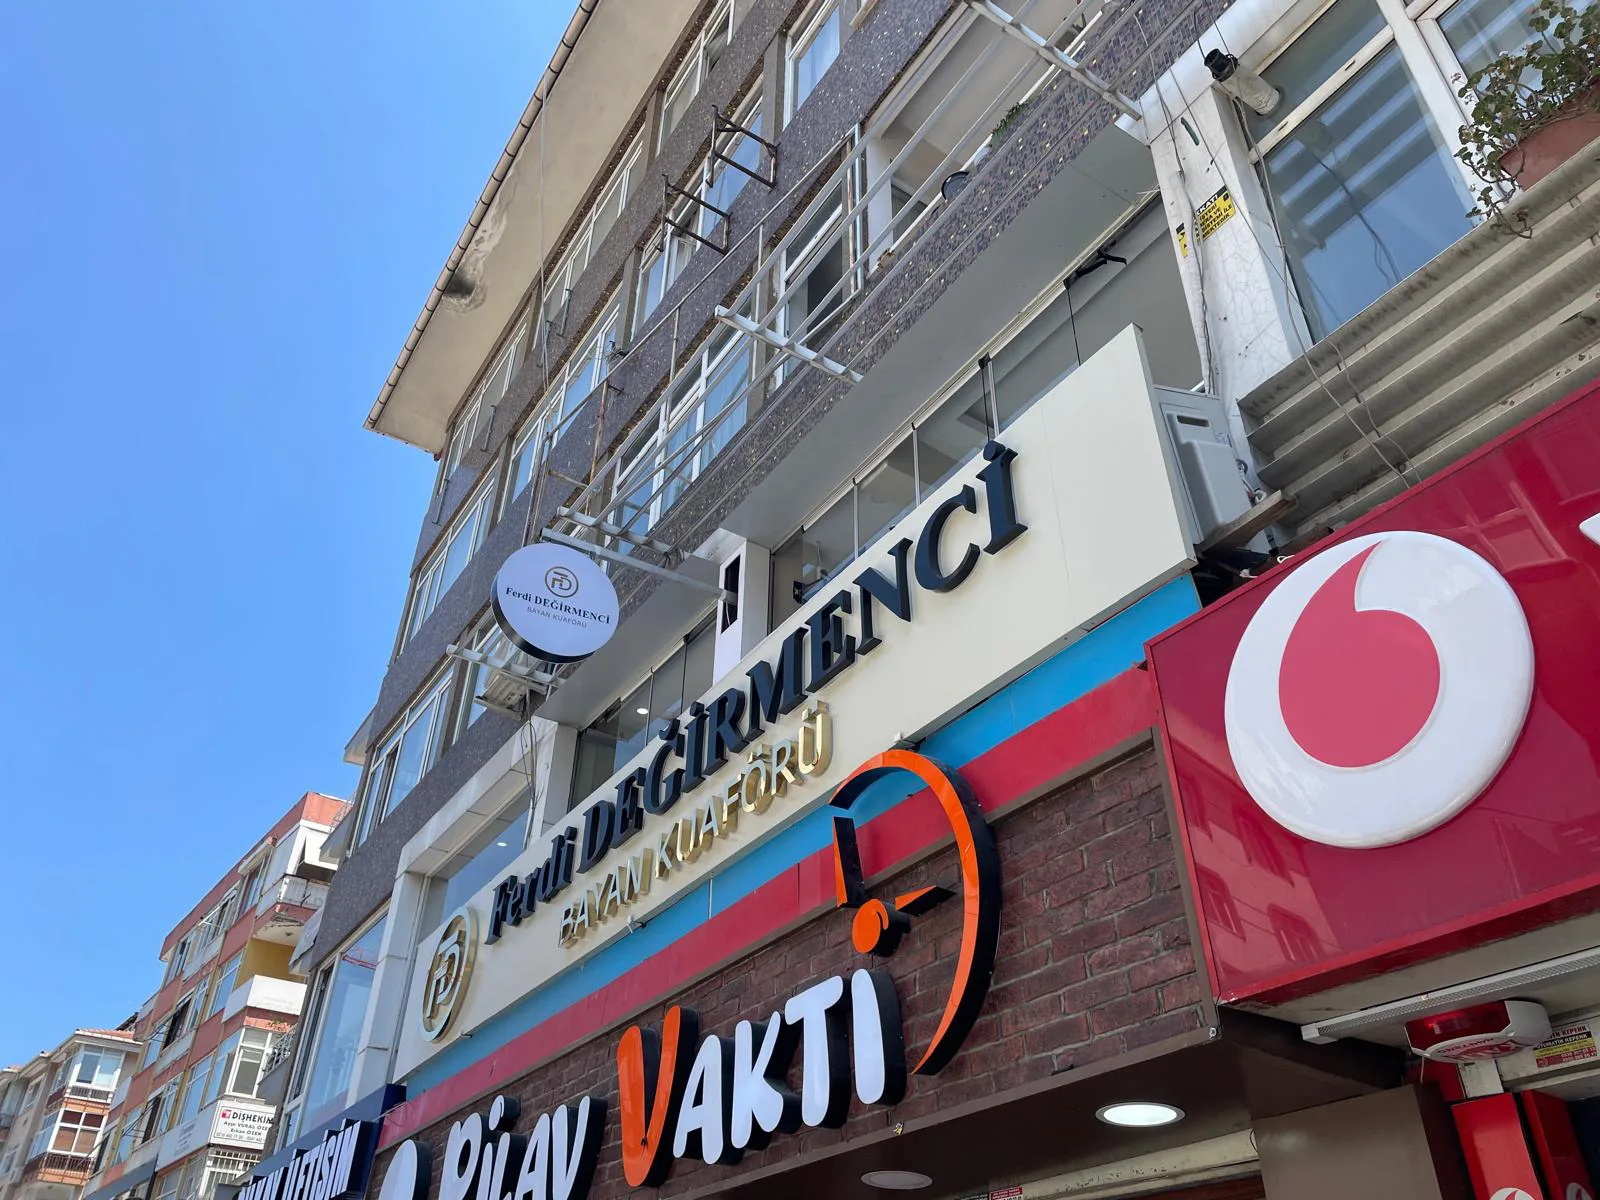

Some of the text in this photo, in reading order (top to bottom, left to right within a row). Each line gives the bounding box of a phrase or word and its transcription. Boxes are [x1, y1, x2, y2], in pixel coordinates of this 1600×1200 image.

[505, 586, 611, 625] Ferdi DEĞİRMENCİ
[526, 606, 588, 628] BAYAN KUAFÖRÜ
[485, 440, 1029, 945] Ferdi DEĞİRMENCİ
[558, 699, 835, 949] BAYAN KUAFÖRÜ
